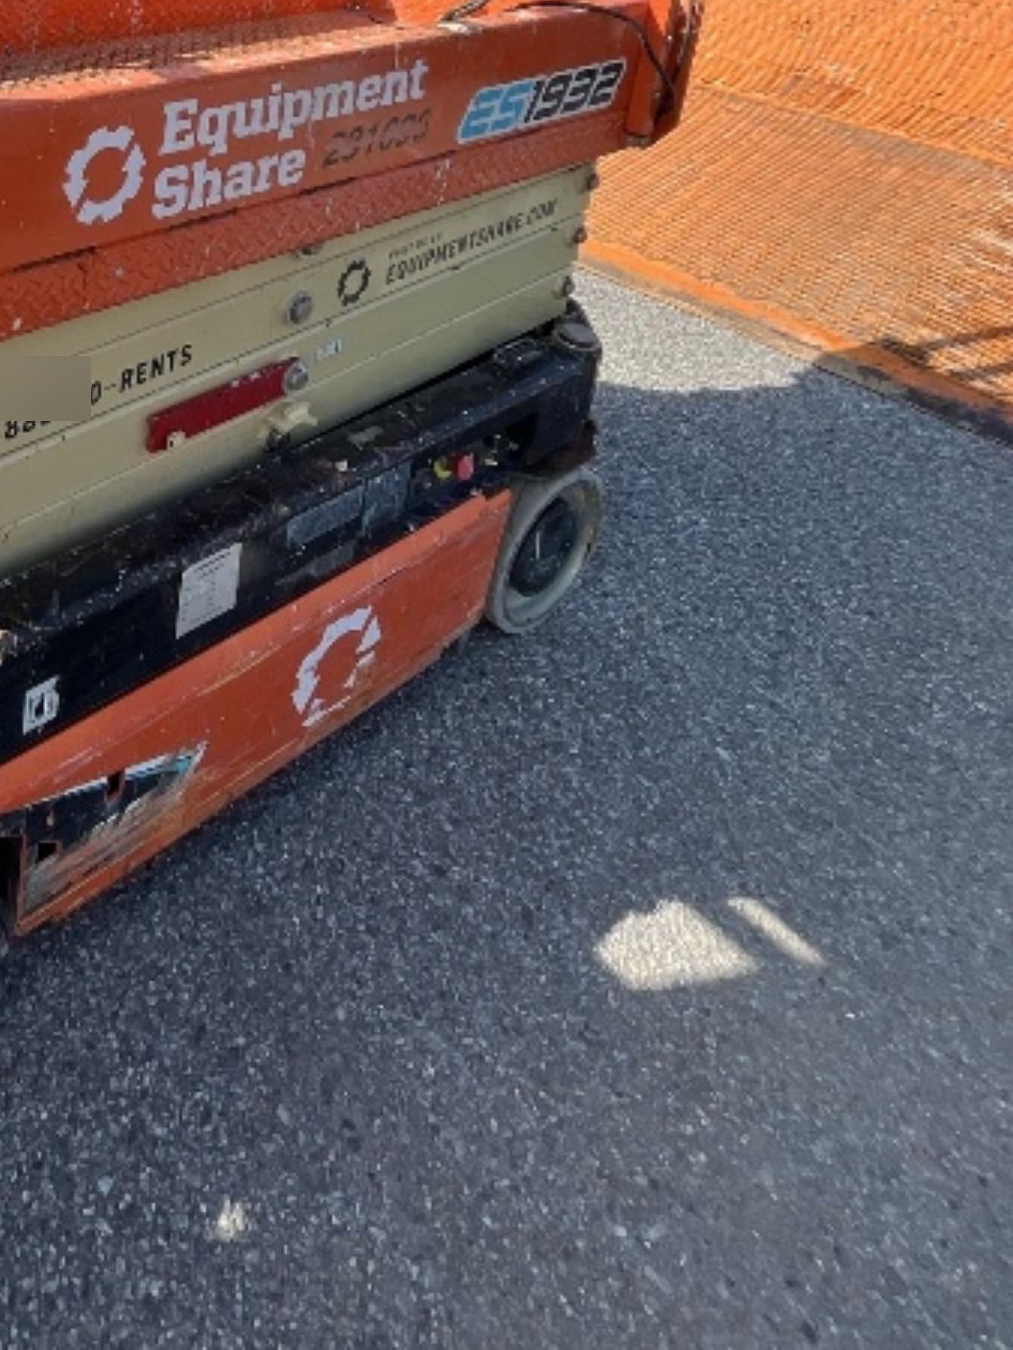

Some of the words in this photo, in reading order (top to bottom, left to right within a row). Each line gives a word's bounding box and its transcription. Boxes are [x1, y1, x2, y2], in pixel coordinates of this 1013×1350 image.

[159, 59, 428, 156] Equipment
[459, 58, 625, 143] ES1932
[151, 148, 306, 220] Share
[386, 199, 559, 285] EQUIPMENTSHARE.COM
